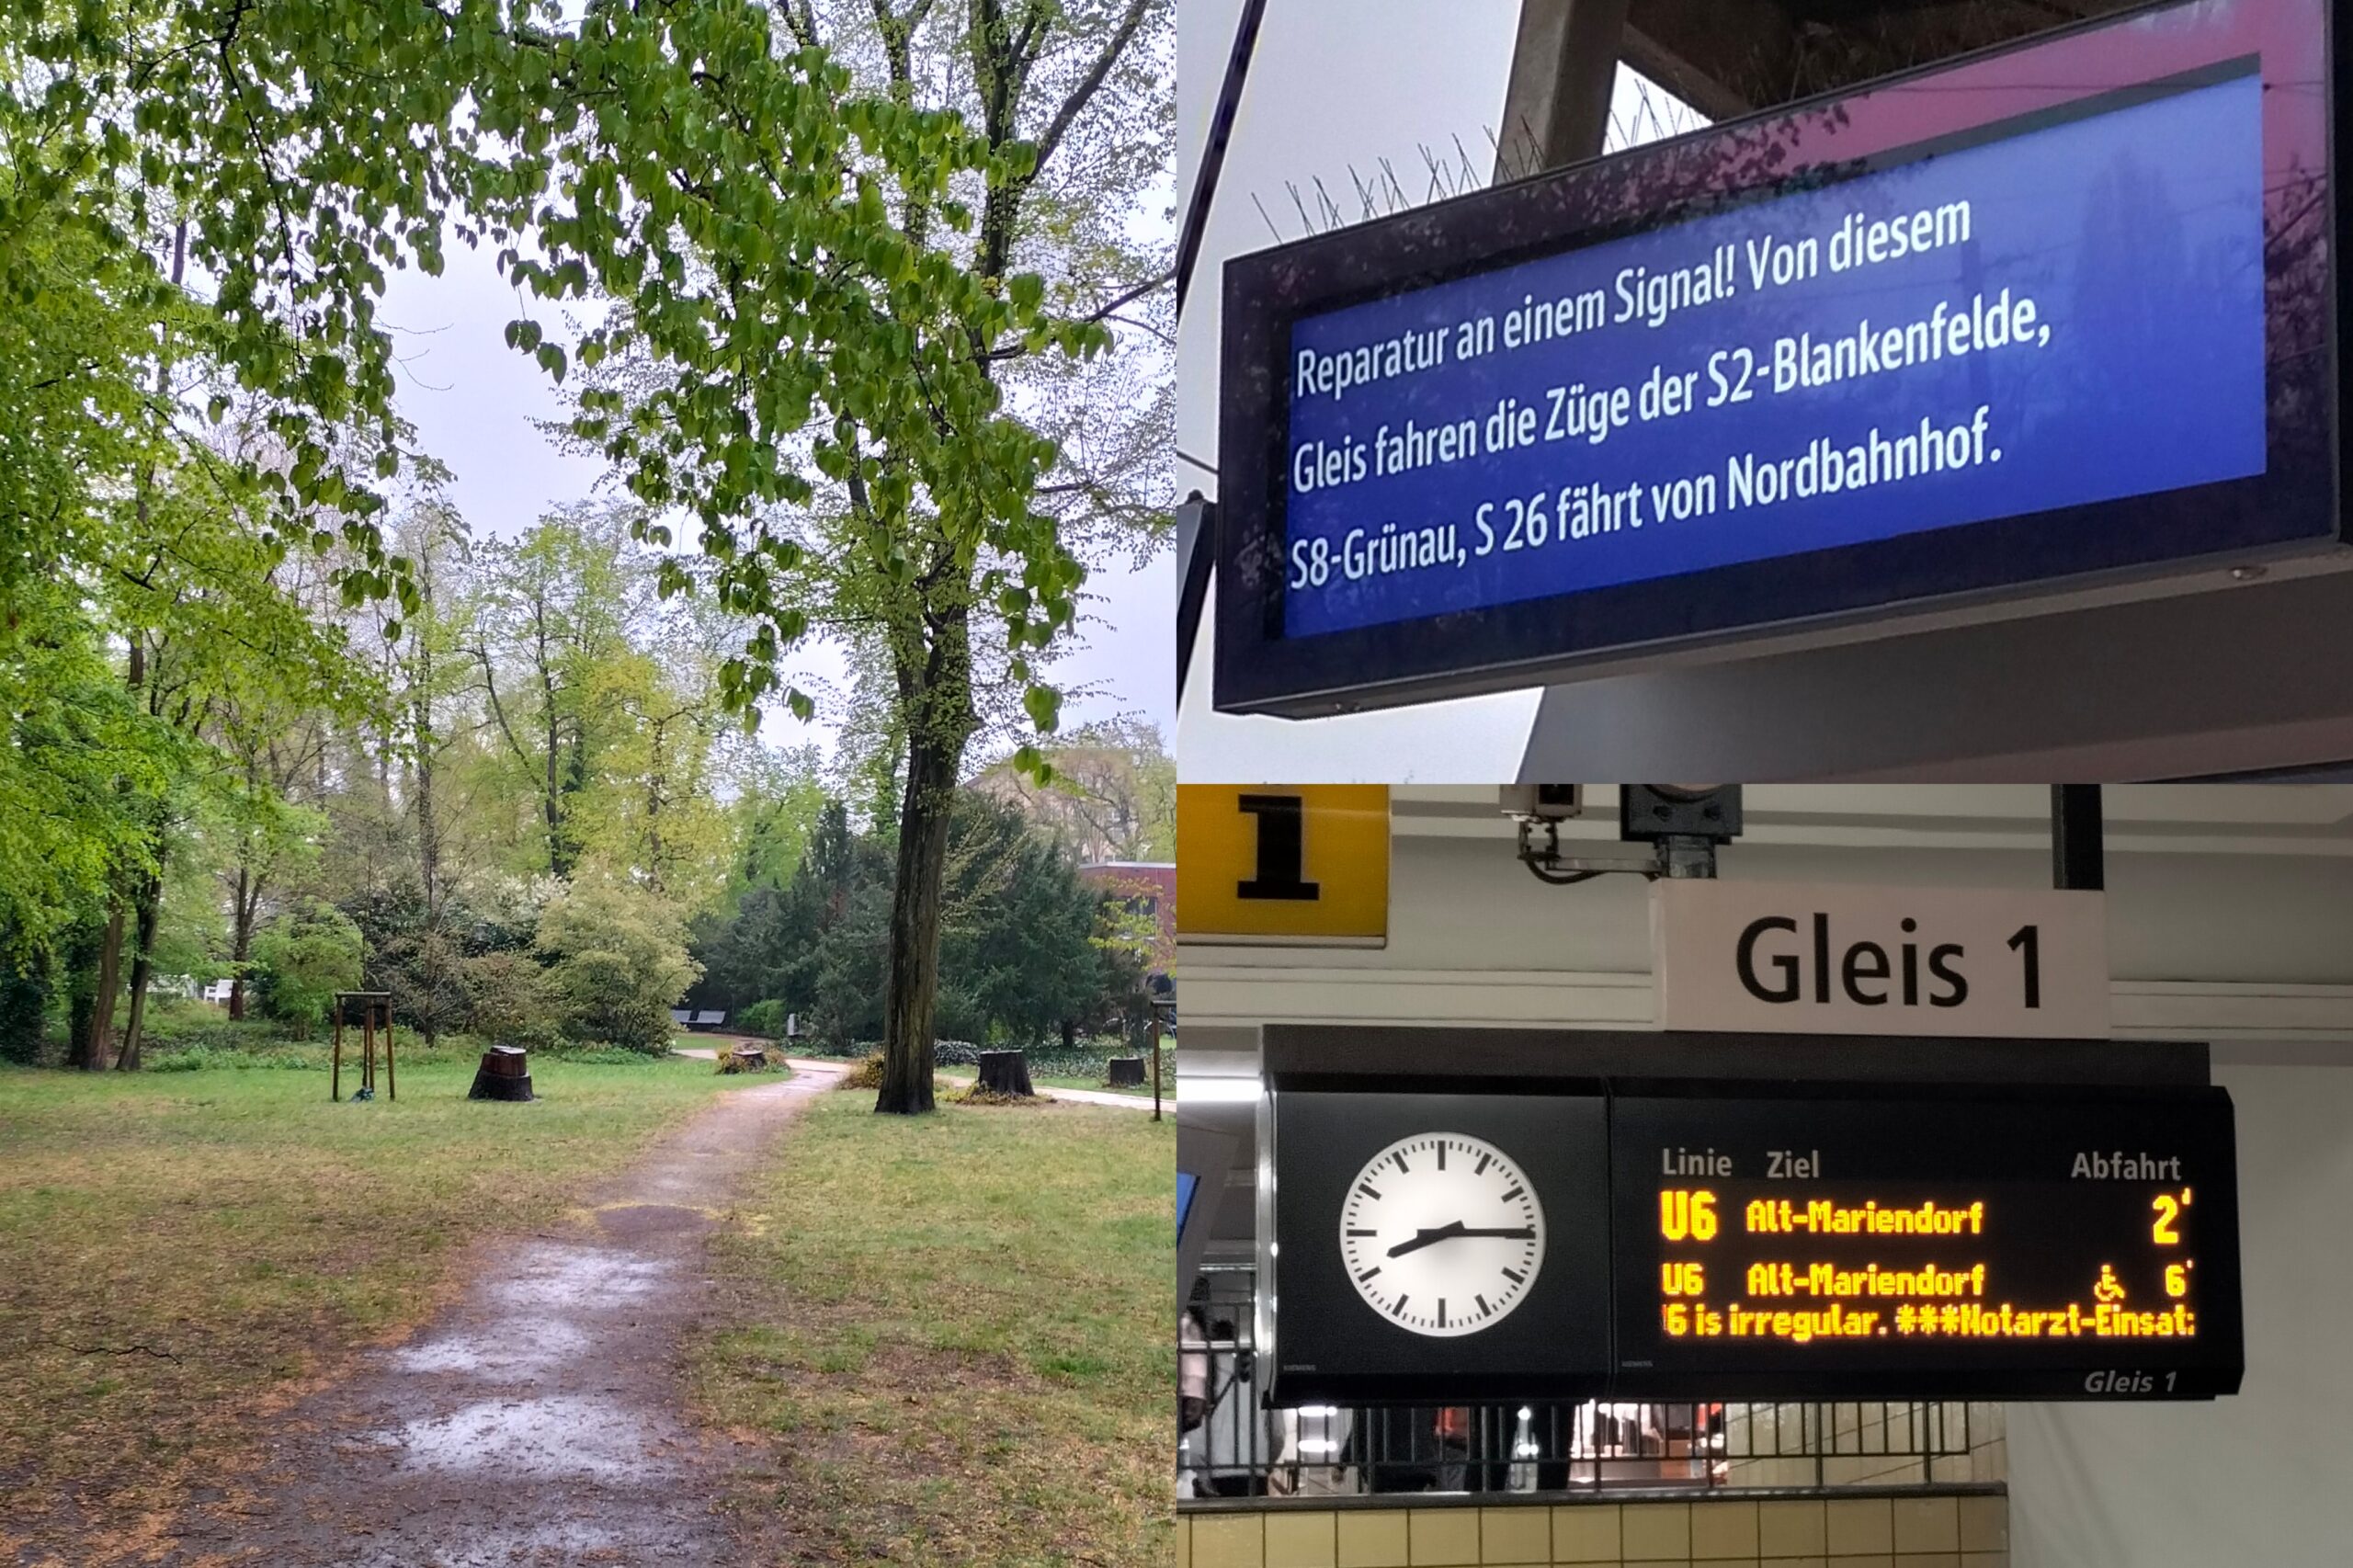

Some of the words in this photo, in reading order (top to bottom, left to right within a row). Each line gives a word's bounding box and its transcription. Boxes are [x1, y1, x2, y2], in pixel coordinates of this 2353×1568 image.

[1297, 325, 1449, 399] Reparatur
[1456, 315, 1495, 359] an
[1503, 288, 1606, 347] einem
[1614, 244, 1735, 328] Signal!
[1746, 233, 1819, 291] Von
[1828, 199, 1972, 272] diesem
[1293, 434, 1368, 493] Gleis
[1374, 418, 1476, 476] fahren
[1485, 397, 1536, 453] die
[1544, 379, 1631, 444] Züge
[1639, 365, 1698, 421] der
[1706, 287, 2052, 407] S2-Blankenfelde,
[1290, 522, 1468, 590] S8-Grünau,
[1502, 491, 1549, 552] 26
[1556, 481, 1643, 541] fährt
[1651, 472, 1716, 524] von
[1727, 404, 2003, 511] Nordbahnhof.
[1736, 913, 1969, 1007] Gleis
[2007, 925, 2042, 1009] 1
[1662, 1148, 1733, 1178] Linie
[1766, 1149, 1820, 1179] Ziel
[2070, 1151, 2182, 1181] Abfahrt
[1660, 1191, 1717, 1241] U6
[1746, 1200, 1984, 1233] Alt-Mariendorf
[1662, 1263, 1704, 1297] U6
[1747, 1263, 1985, 1297] Alt-Mariendorf
[1662, 1303, 1688, 1336] 6
[1695, 1303, 1722, 1336] is
[1729, 1302, 1888, 1343] irregular.
[2083, 1370, 2156, 1393] Gleis
[2163, 1371, 2177, 1393] 1
